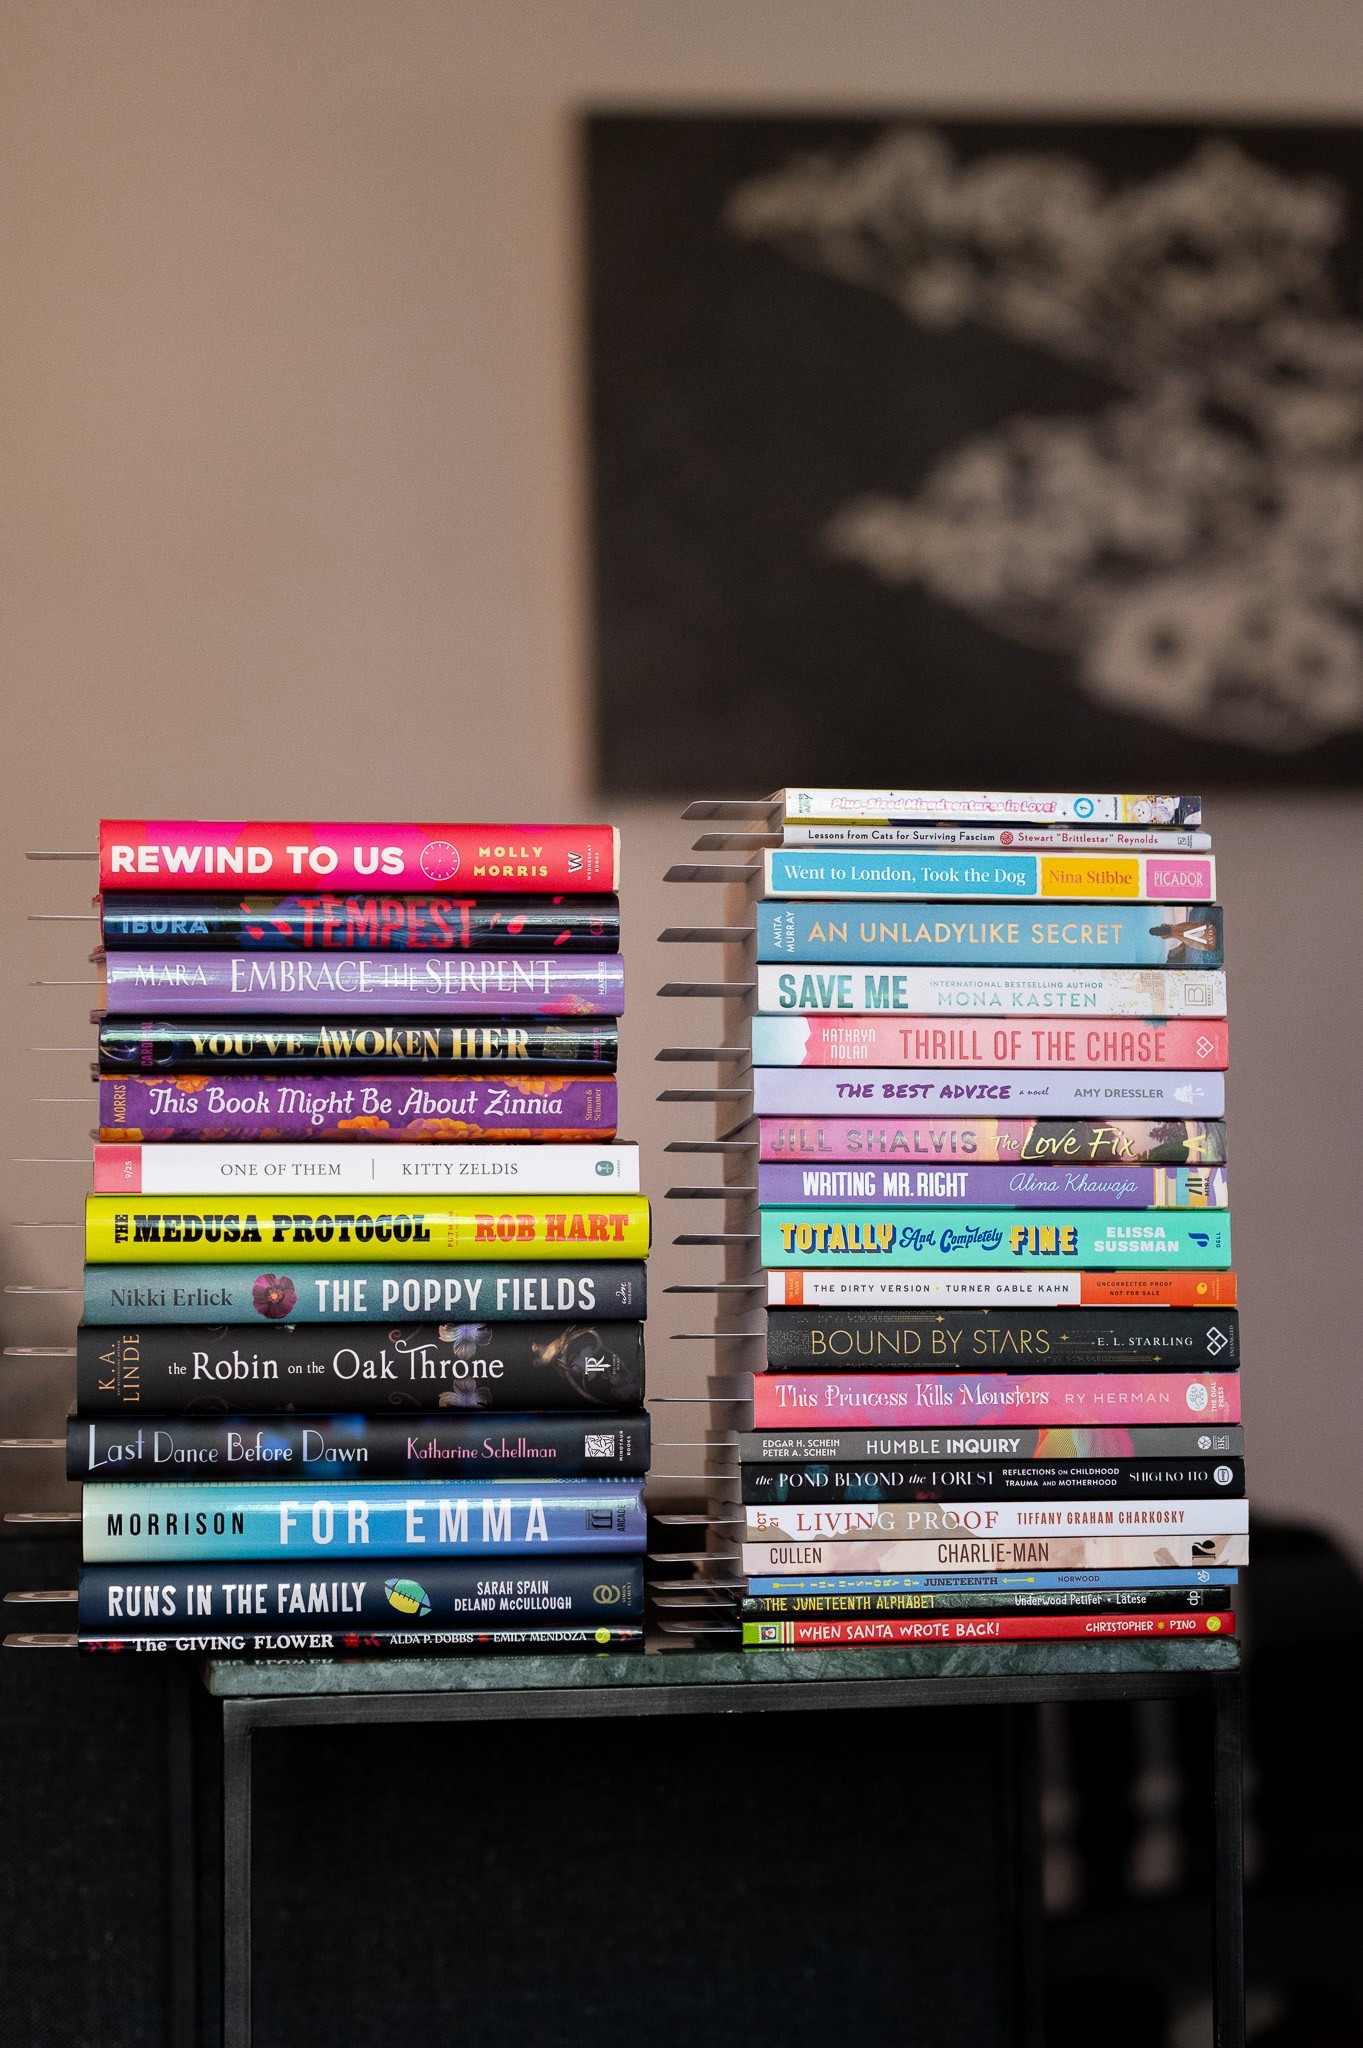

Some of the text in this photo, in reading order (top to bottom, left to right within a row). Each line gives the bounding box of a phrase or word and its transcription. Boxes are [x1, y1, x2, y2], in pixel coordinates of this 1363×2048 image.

[831, 796, 1057, 813] Plus-Sized Misadventures in Love!
[808, 830, 995, 842] Lessons from Cats for Surviving Fascism
[1018, 833, 1053, 842] Stewart
[1118, 835, 1158, 845] Reynolds
[478, 846, 543, 858] MOLLY
[111, 845, 404, 875] REWIND TO US
[473, 866, 548, 877] MORRIS
[1050, 870, 1132, 884] Nina Stibbe
[1154, 872, 1203, 886] PICADOR
[122, 916, 209, 934] IBURA
[296, 894, 477, 948] TEMPEST
[773, 916, 782, 948] AMITA
[134, 965, 207, 986] MARA
[230, 957, 556, 994] EMBRACE THE SERPENT
[1005, 981, 1063, 989] BESTSELLING
[938, 992, 1097, 1007] MONA KASTEN
[822, 1028, 876, 1043] KATHRYN
[314, 1025, 442, 1062] AWOKEN
[452, 1027, 530, 1060] HER
[899, 1029, 1166, 1062] THRILL OF THE CHASE
[831, 1045, 868, 1059] NOLAN
[836, 1083, 1011, 1099] THE BEST ADVICE
[1028, 1087, 1049, 1095] novel
[1074, 1089, 1164, 1098] AMY DRESSLER
[114, 1084, 126, 1123] MORRIS
[991, 1126, 1138, 1159] The Love Fix
[125, 1160, 133, 1179] 9/25
[220, 1164, 341, 1176] ONE OF THEM
[402, 1163, 518, 1175] KITTY ZELDIS
[1010, 1173, 1138, 1199] Alina Khawaja
[115, 1214, 129, 1243] THE
[133, 1214, 262, 1242] MEDUSA
[272, 1214, 430, 1242] PROTOCOL
[474, 1214, 536, 1242] ROB
[545, 1214, 629, 1242] HART
[1106, 1227, 1166, 1238] ELISSA
[1094, 1240, 1179, 1252] SUSSMAN
[110, 1288, 233, 1307] Nikki Erlick
[812, 1330, 1050, 1355] BOUND BY STARS
[1097, 1337, 1193, 1346] E. L. STARLING
[123, 1333, 140, 1401] LINDE
[1065, 1393, 1170, 1403] RY HERMAN
[88, 1424, 369, 1471] Last Dance Before Dawn
[407, 1437, 556, 1459] Katharine Schellman
[796, 1439, 805, 1447] H.
[808, 1439, 840, 1447] SCHEIN
[867, 1438, 1020, 1454] HUMBLE INQUIRY
[1218, 1437, 1225, 1449] BK
[763, 1449, 789, 1457] PETER
[1129, 1471, 1208, 1482] SHIGEKO ITO
[107, 1512, 244, 1536] MORRISON
[617, 1504, 626, 1532] ARCADE
[757, 1512, 766, 1531] OCT
[770, 1517, 779, 1527] 21
[1017, 1511, 1185, 1525] TIFFANY GRAHAM CHARKOSKY
[770, 1547, 822, 1564] CULLEN
[938, 1542, 1049, 1564] CHARLIE-MAN
[924, 1577, 998, 1587] JUNETEENTH
[1058, 1575, 1100, 1583] NORWOOD
[477, 1581, 549, 1595] SARAH SPAIN
[455, 1596, 571, 1611] DELAND McCULLOUGH
[765, 1596, 936, 1611] THE JUNETEENTH ALPHABET
[1015, 1595, 1067, 1606] Underwood
[1070, 1594, 1102, 1605] Petifer
[1086, 1620, 1196, 1632] CHRISTOPHER PINO
